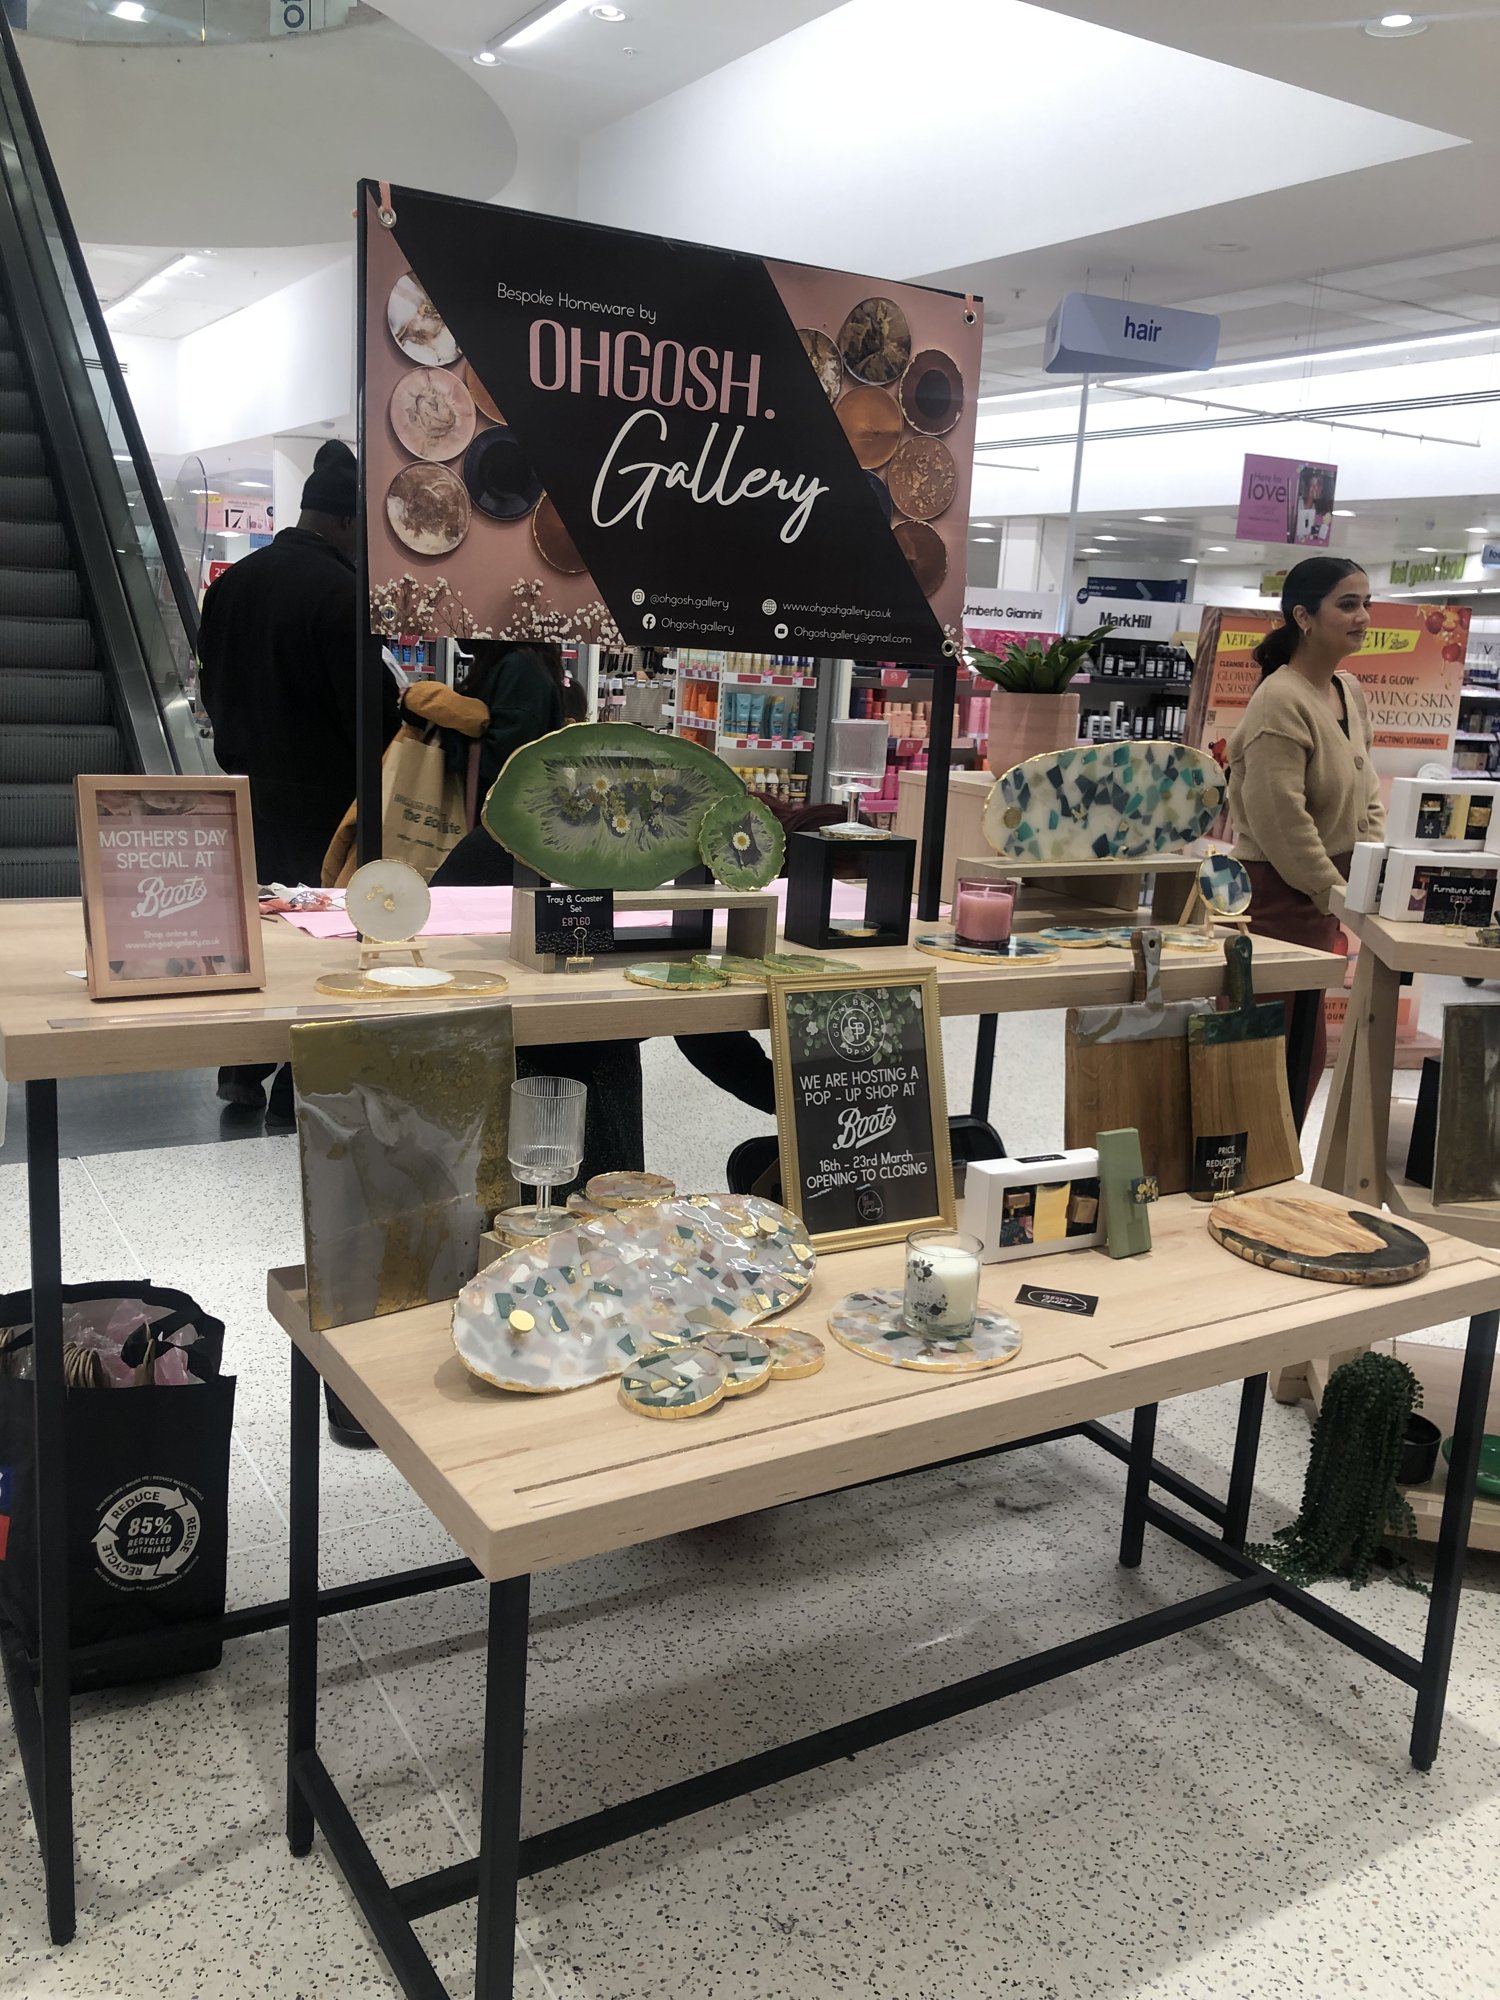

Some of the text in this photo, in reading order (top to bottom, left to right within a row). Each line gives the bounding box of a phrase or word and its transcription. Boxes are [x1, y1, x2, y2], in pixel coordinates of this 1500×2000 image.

[497, 282, 657, 324] Bespoke Homeware by
[1124, 315, 1162, 342] hair
[529, 318, 775, 419] OHGOSH.
[591, 408, 830, 544] Gallery
[1247, 473, 1287, 503] love
[1438, 553, 1467, 580] food
[650, 593, 729, 611] @ohgosh.gallery
[782, 601, 892, 620] www.ohgoshgallery.co.uk
[1005, 606, 1043, 620] Giannini
[661, 616, 735, 636] Ohgosh.gallery
[793, 625, 913, 645] Ohgosh.gallery@gmail.com
[1222, 632, 1249, 647] NEW
[1362, 630, 1393, 649] EW
[1219, 660, 1244, 668] CLEANSE
[1380, 675, 1386, 684] &
[1420, 691, 1455, 709] SKIN
[1376, 709, 1452, 729] SECONDS
[1406, 737, 1435, 746] VITAMIN
[1435, 738, 1441, 746] C
[99, 829, 229, 848] MOTHER'S DAY
[116, 850, 215, 869] SPECIAL AT
[130, 875, 208, 919] Boots
[546, 894, 604, 906] Tray & Coaster
[1432, 884, 1492, 896] Furniture Knobs
[569, 904, 583, 913] Set
[799, 1065, 919, 1090] WE ARE HOSTING A
[804, 1090, 832, 1106] POP
[845, 1087, 861, 1102] UP
[866, 1084, 899, 1101] SHOP
[902, 1081, 916, 1096] AT
[832, 1103, 897, 1150] Boots
[1218, 1145, 1235, 1155] PRICE
[819, 1157, 841, 1173] 16th
[853, 1153, 878, 1169] 23rd
[880, 1149, 914, 1165] March
[1205, 1156, 1242, 1168] REDUCTION
[806, 1161, 928, 1190] OPENING TO CLOSING
[111, 1491, 160, 1520] REDUCE
[127, 1515, 172, 1536] 85%
[180, 1516, 197, 1554] REUSE
[126, 1545, 171, 1557] MATERIALS
[127, 1536, 172, 1548] RECYCLED
[102, 1543, 144, 1577] RECYCLE
